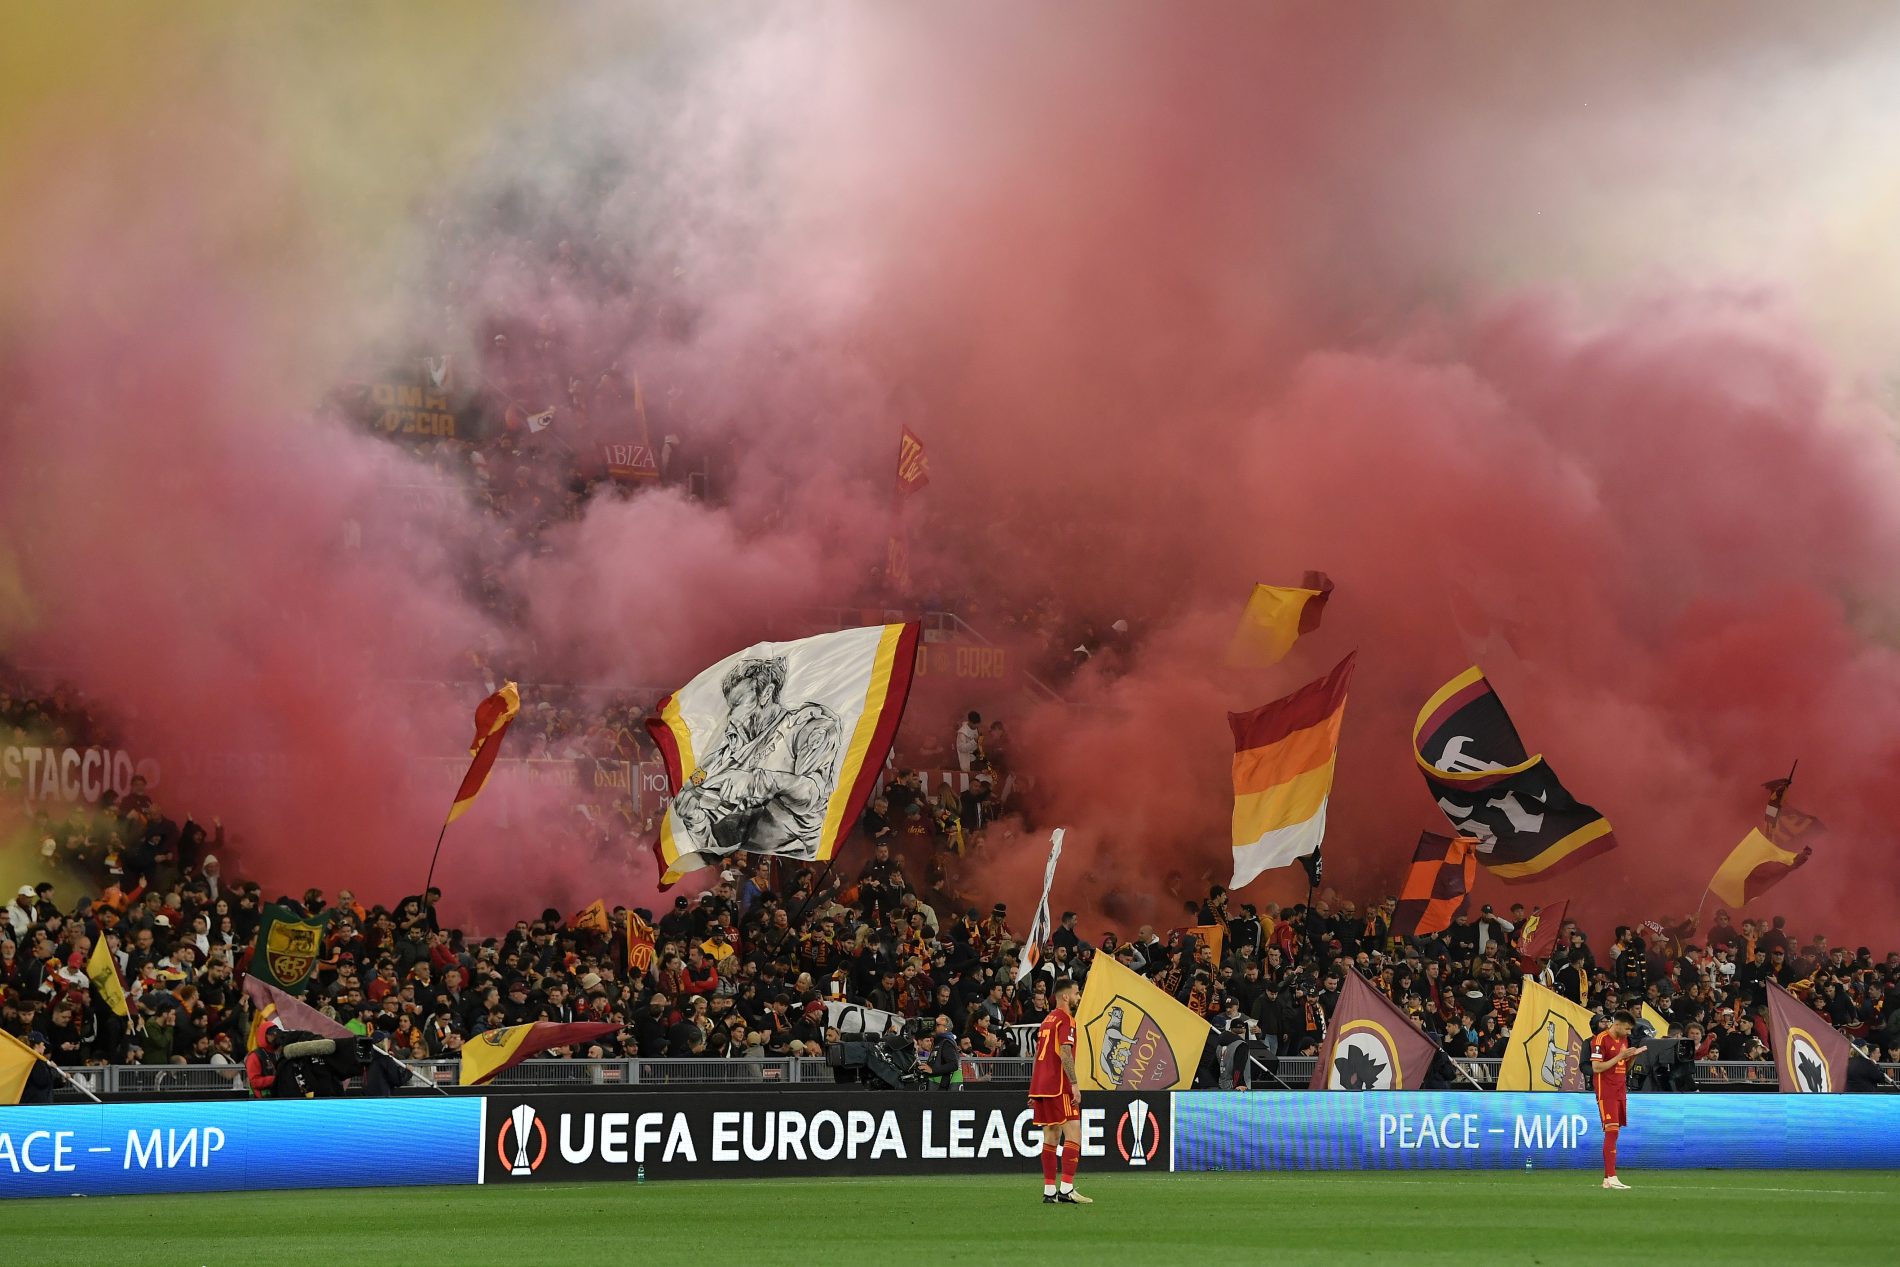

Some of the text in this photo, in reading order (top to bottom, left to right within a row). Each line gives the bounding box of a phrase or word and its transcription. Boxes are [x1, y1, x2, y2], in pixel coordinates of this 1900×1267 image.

[605, 444, 656, 468] IBIZA
[1037, 1029, 1050, 1060] 7
[123, 1126, 225, 1170] МИР
[560, 1108, 1106, 1164] UEFA EUROPA LEAGE
[1379, 1113, 1480, 1149] PEACE
[1513, 1114, 1588, 1149] МИР
